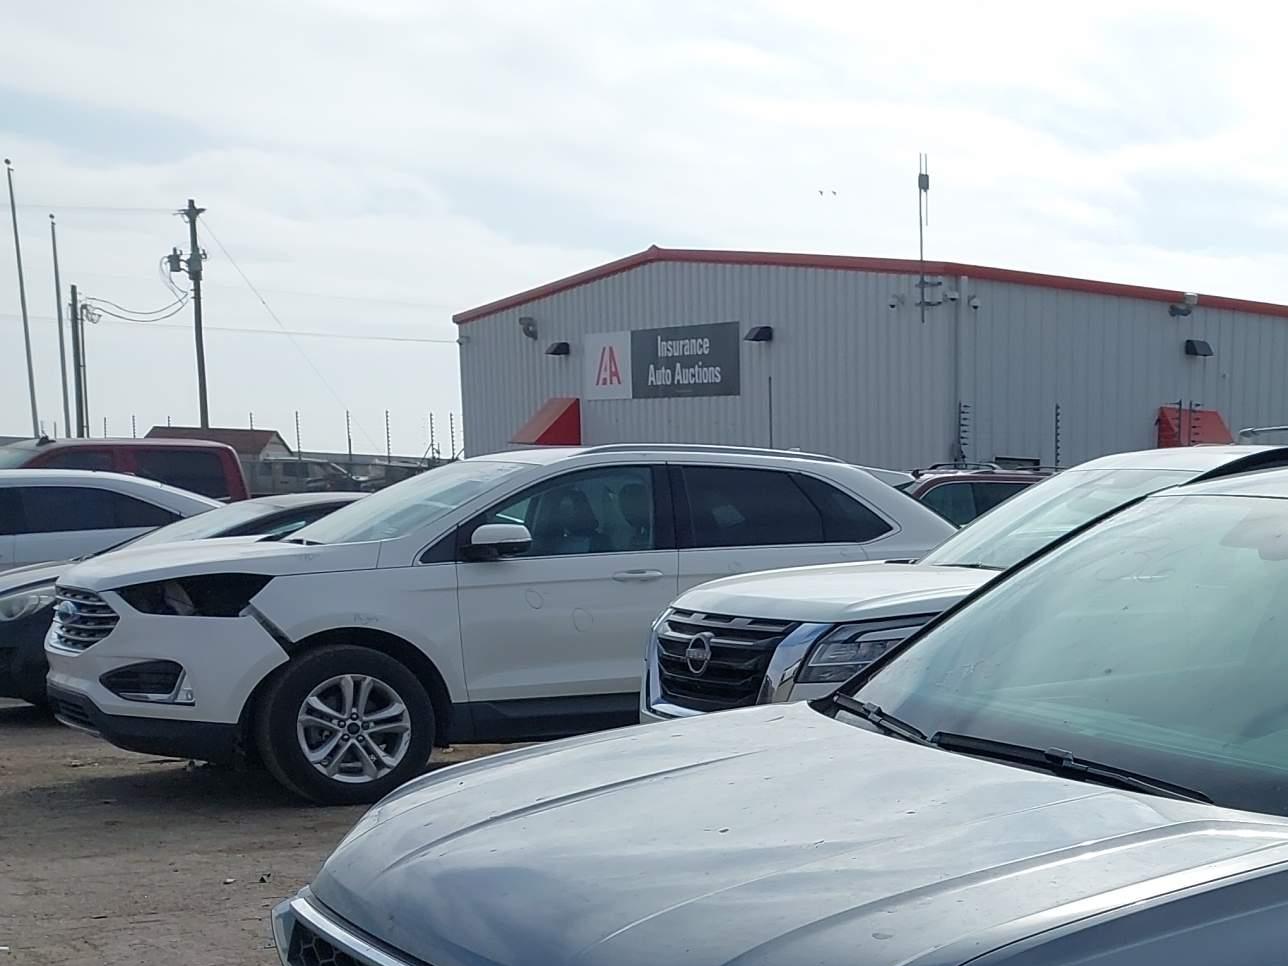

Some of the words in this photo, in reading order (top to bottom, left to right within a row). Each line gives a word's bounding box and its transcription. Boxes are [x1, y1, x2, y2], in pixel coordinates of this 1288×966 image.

[657, 335, 711, 357] Insurance
[648, 364, 672, 386] Auto
[674, 361, 722, 385] Auctions
